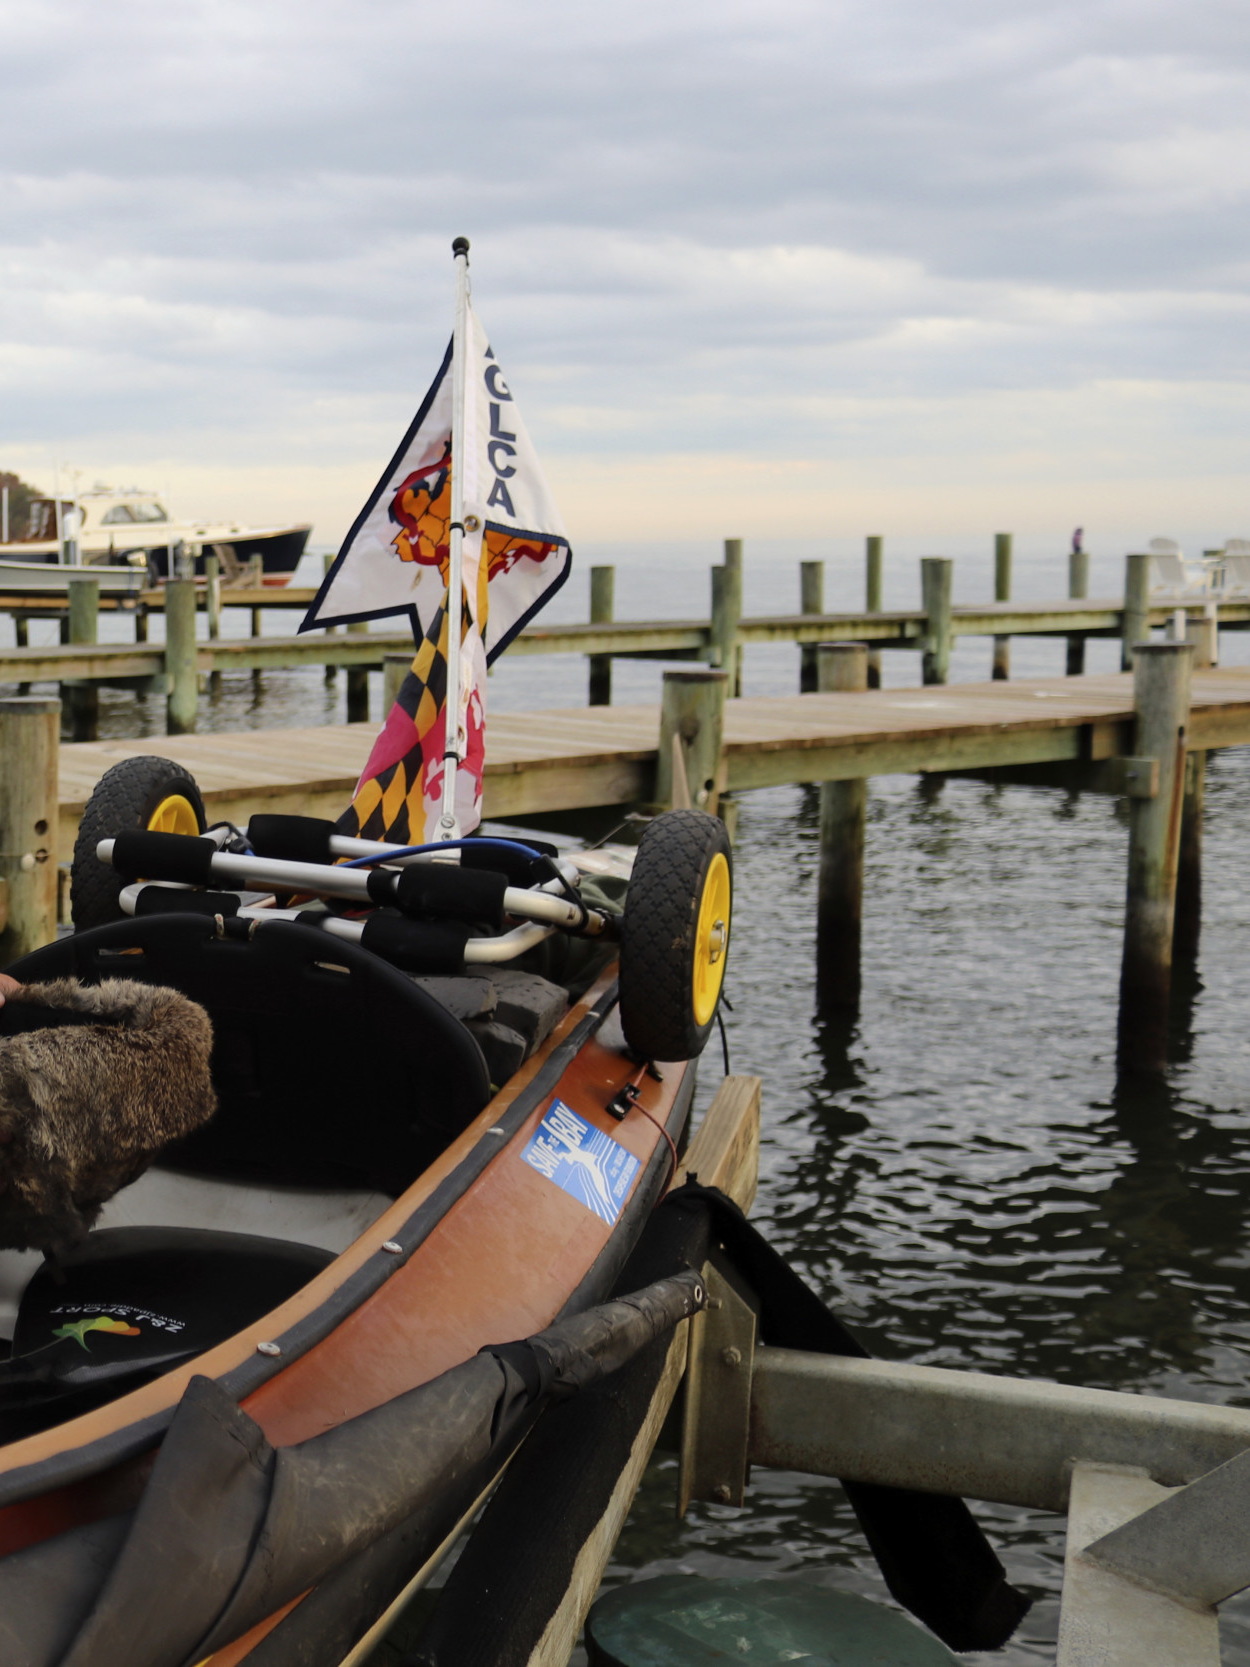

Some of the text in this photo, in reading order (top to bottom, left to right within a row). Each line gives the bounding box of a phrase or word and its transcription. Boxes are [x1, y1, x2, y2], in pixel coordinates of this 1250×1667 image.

[484, 345, 517, 518] GLCA
[527, 1136, 561, 1178] SAVE
[549, 1101, 588, 1147] BAY
[49, 1306, 131, 1316] SPORT
